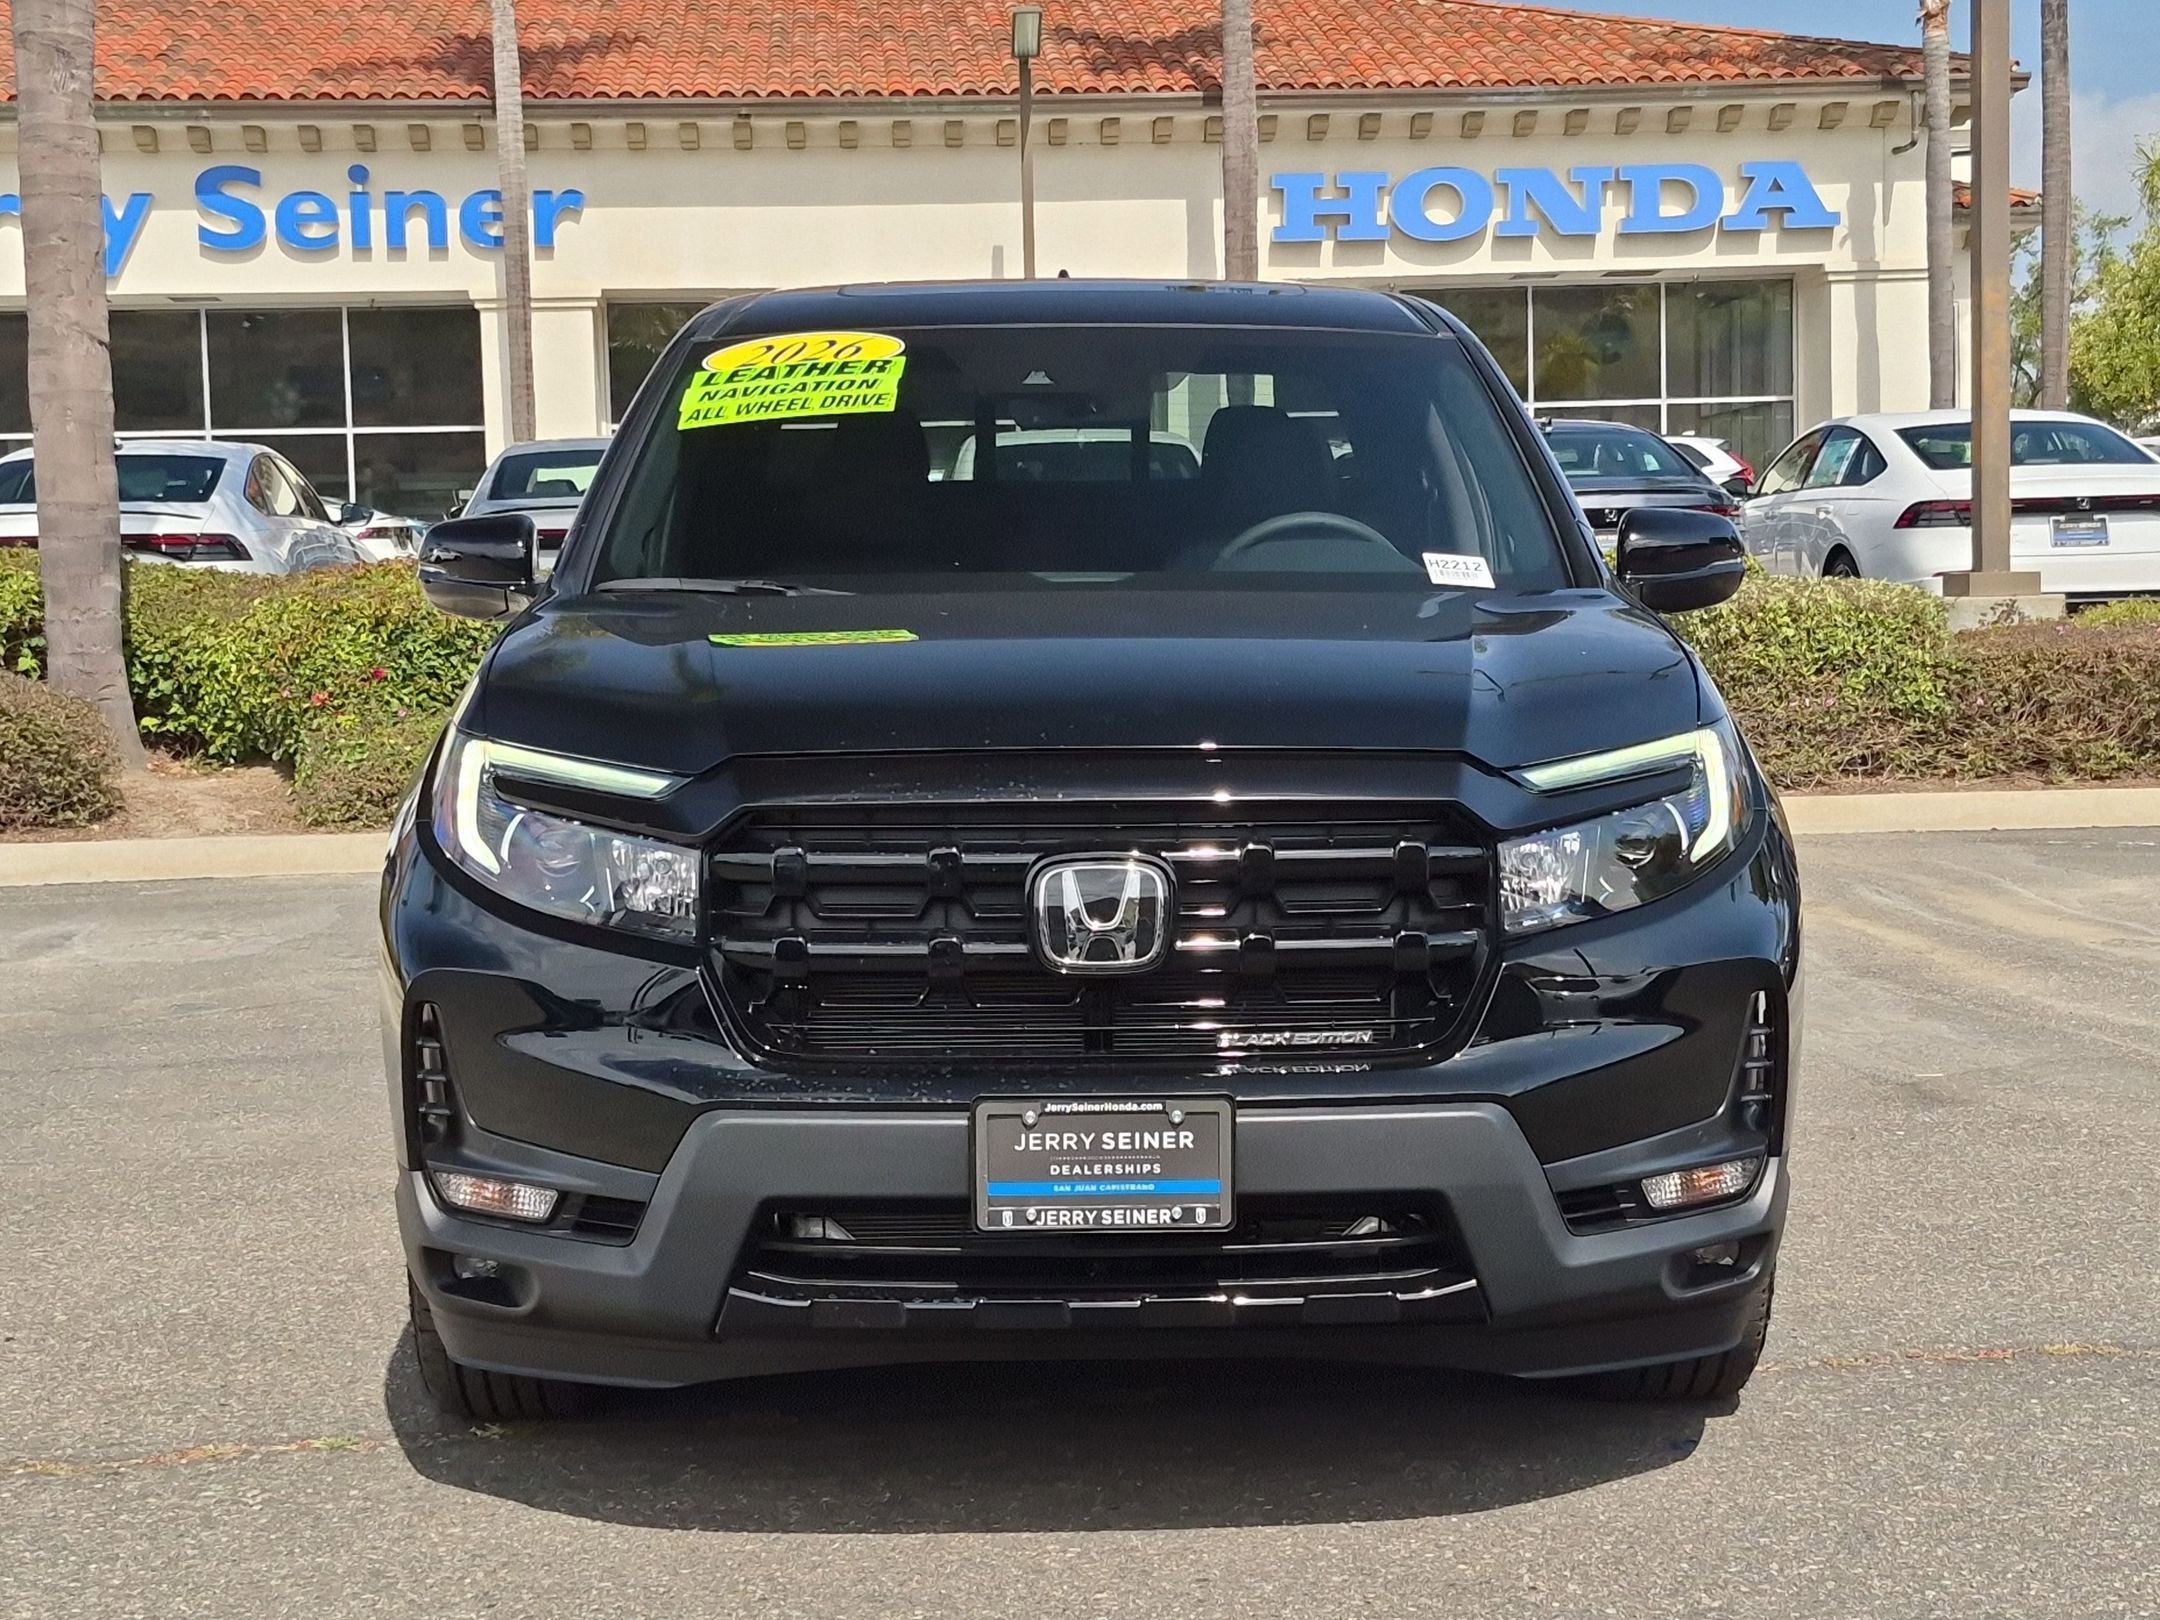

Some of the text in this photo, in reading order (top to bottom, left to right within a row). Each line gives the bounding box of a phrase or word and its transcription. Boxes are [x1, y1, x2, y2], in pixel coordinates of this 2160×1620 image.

[194, 164, 585, 251] Seiner
[1271, 160, 1841, 243] HONDA
[737, 339, 873, 367] 2026
[700, 358, 894, 388] LEATHER
[698, 378, 880, 403] NAVIGATION
[685, 391, 891, 423] ALL WHEEL DRIVE
[1428, 559, 1482, 571] H2212
[1291, 1029, 1374, 1045] EDITION
[1044, 1101, 1163, 1113] JerrySeinerHonda.com
[1014, 1130, 1195, 1152] JERRY SEINER
[1049, 1163, 1162, 1176] DEALERSHIPS
[1053, 1184, 1072, 1192] SAN
[1074, 1184, 1097, 1192] JUAN
[1035, 1208, 1172, 1226] JERRY SEINER
